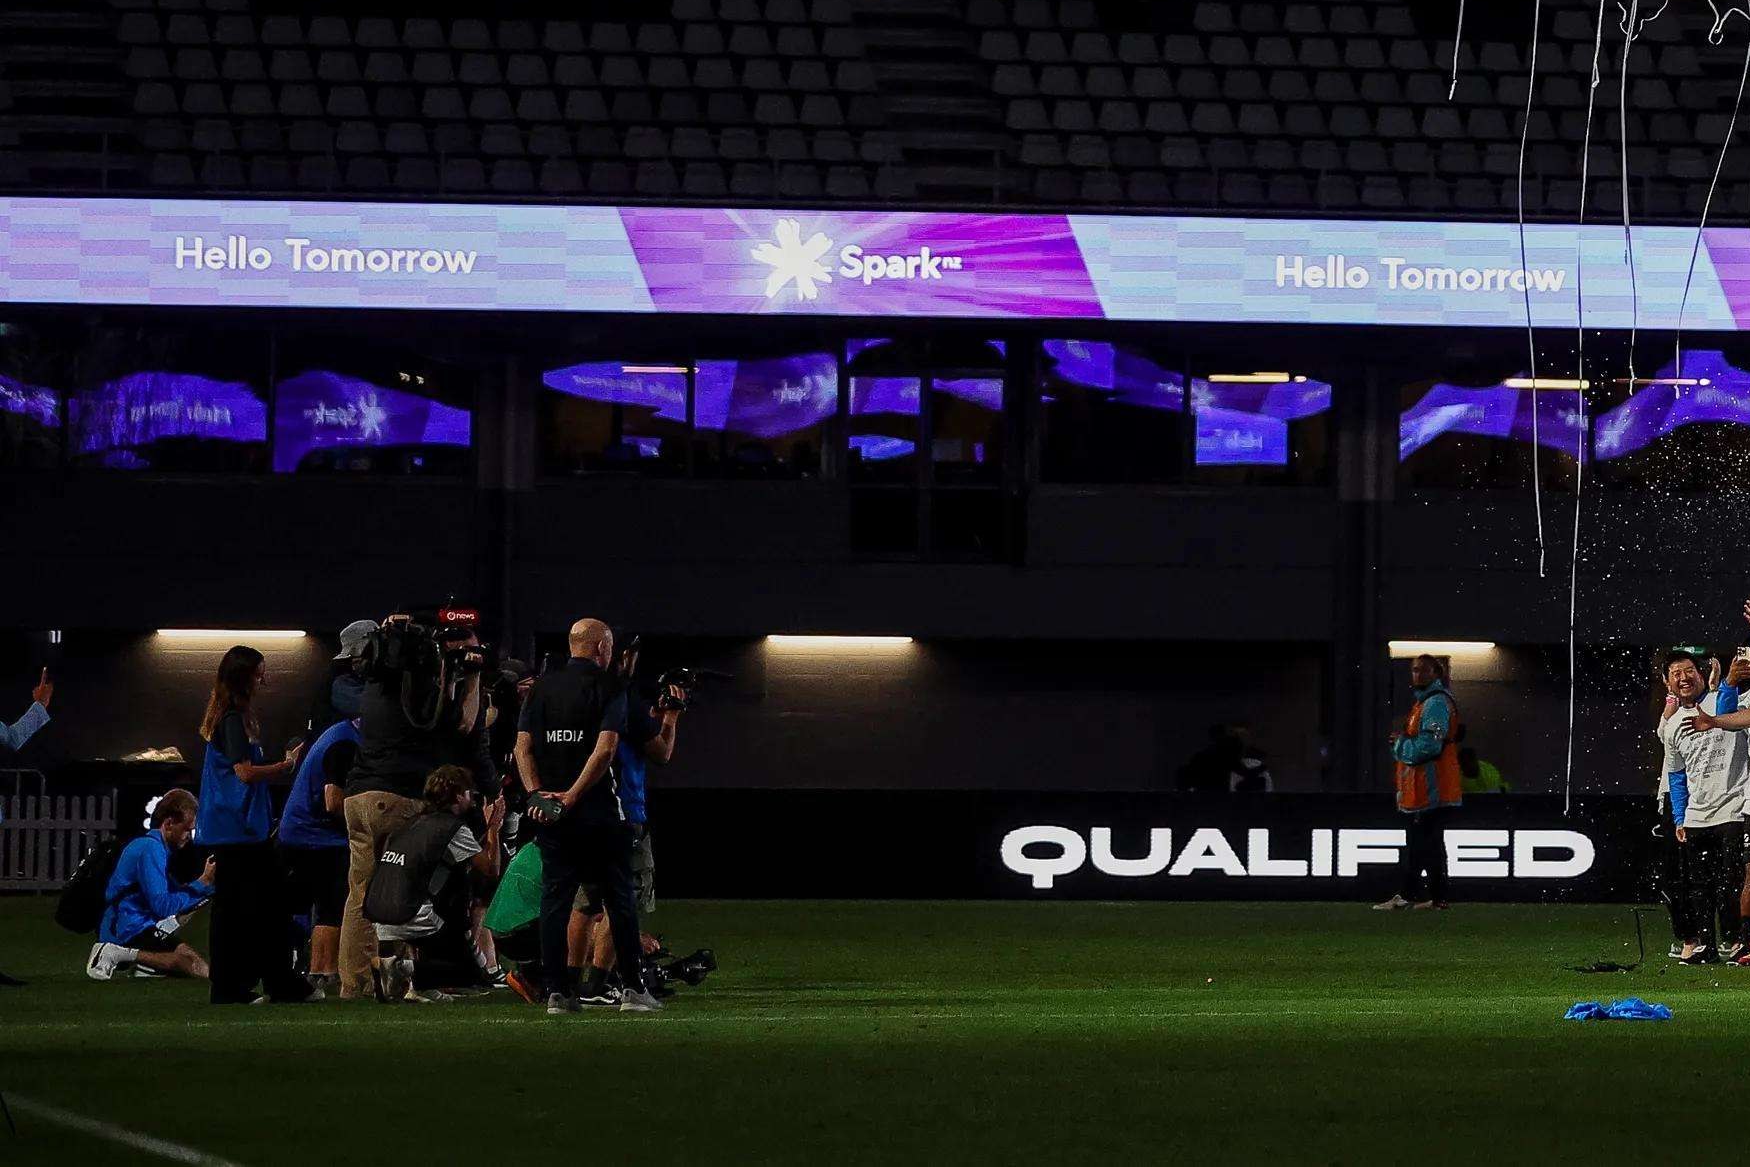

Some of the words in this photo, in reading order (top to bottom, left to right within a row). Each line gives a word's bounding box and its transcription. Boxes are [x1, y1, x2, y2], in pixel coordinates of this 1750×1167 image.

[174, 235, 272, 272] Hello
[284, 237, 478, 276] Tomorrow
[839, 245, 943, 286] Spark
[1275, 254, 1370, 290] Hello
[1380, 256, 1567, 294] Tomorrow
[456, 612, 475, 620] news
[546, 729, 584, 742] MEDIA
[999, 824, 1594, 888] QUALIFED
